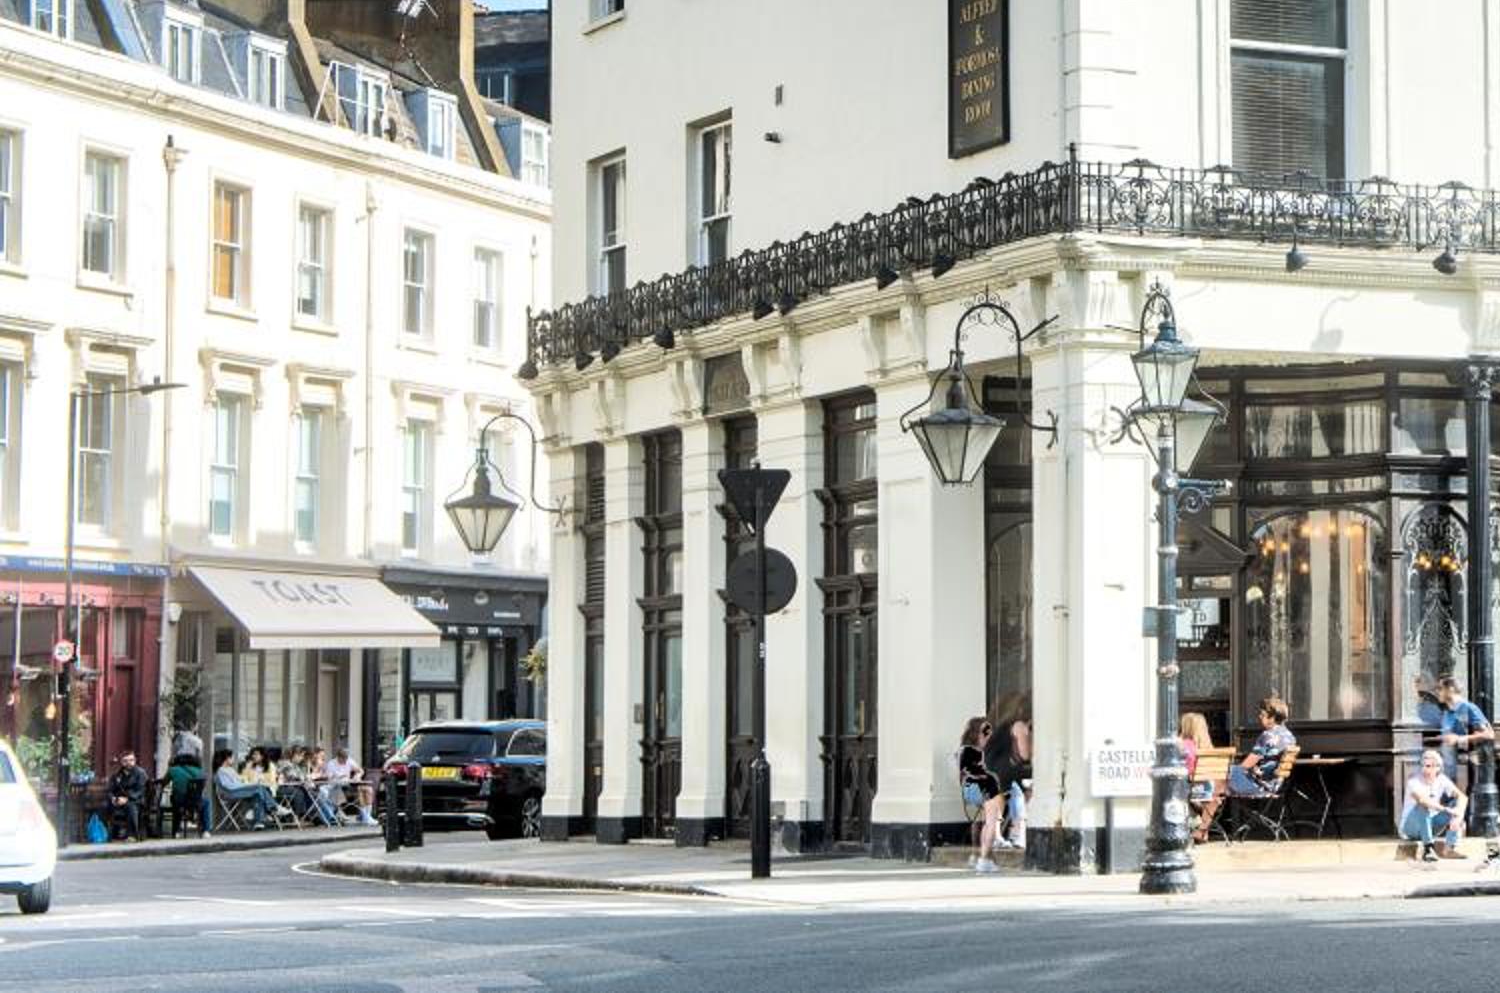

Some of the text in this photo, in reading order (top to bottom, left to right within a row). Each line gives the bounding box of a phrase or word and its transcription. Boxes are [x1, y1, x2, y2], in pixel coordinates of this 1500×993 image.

[974, 23, 985, 46] &
[251, 579, 352, 606] TOAST
[1098, 766, 1131, 780] ROAD
